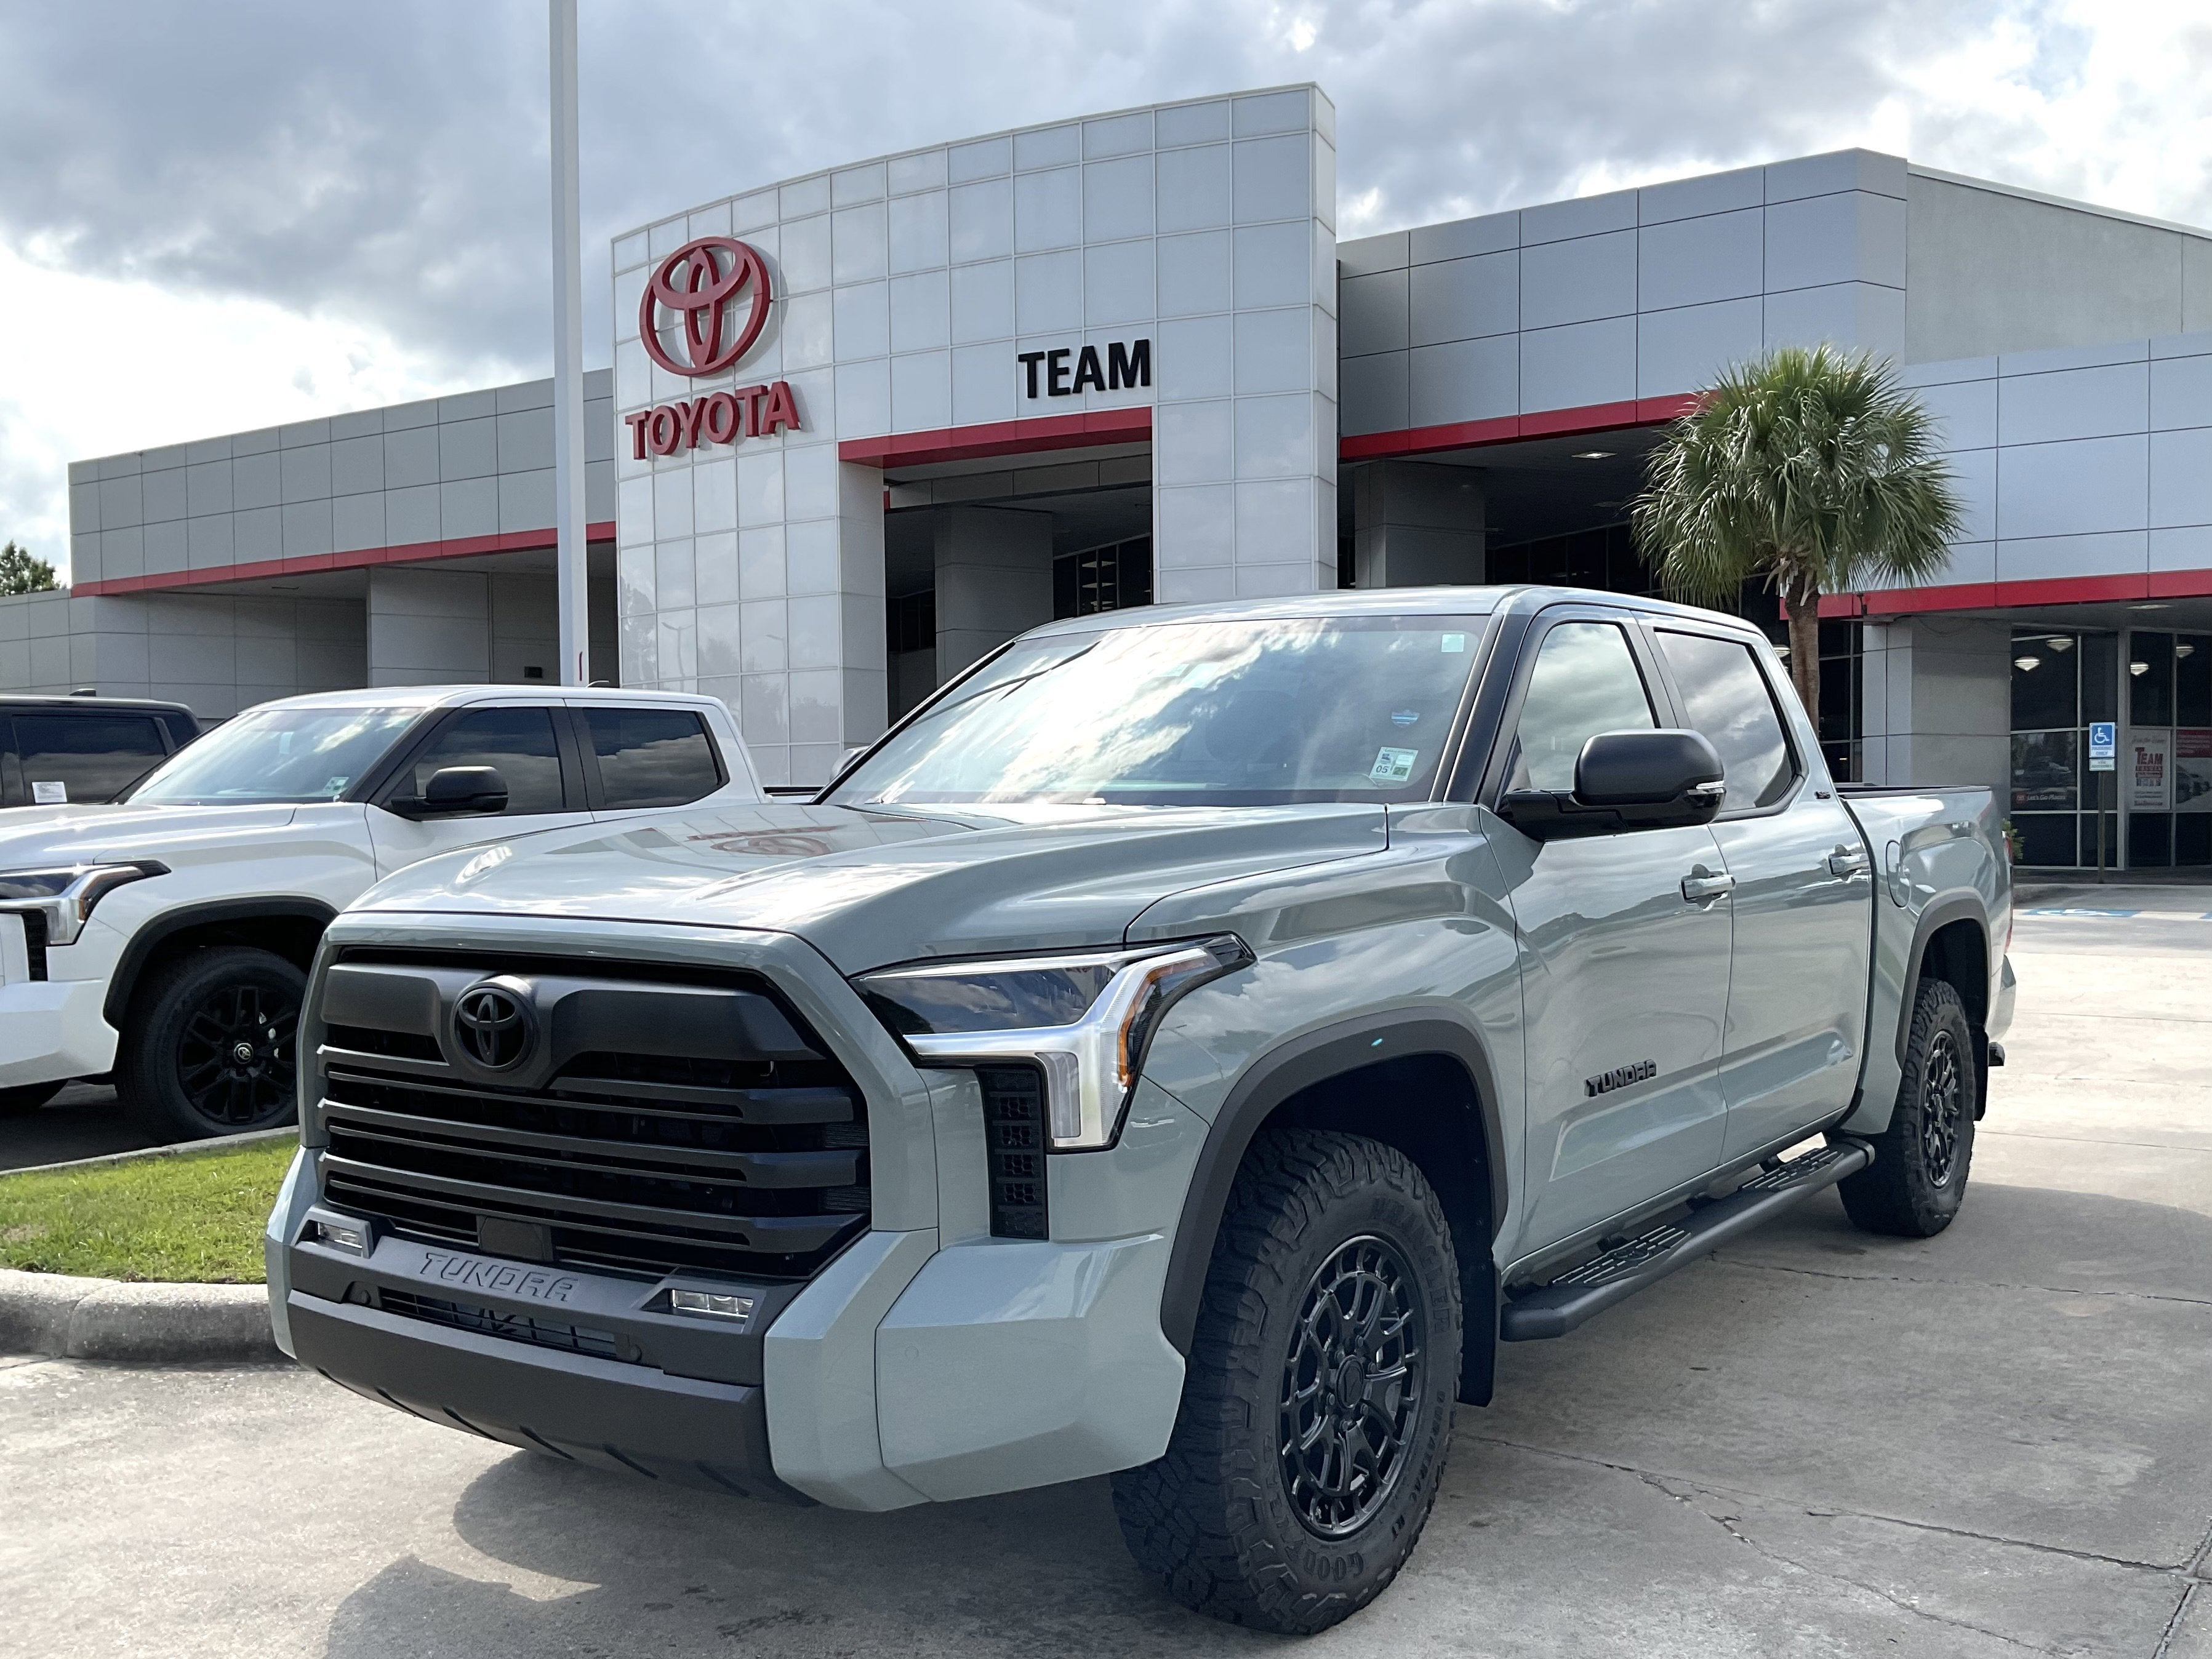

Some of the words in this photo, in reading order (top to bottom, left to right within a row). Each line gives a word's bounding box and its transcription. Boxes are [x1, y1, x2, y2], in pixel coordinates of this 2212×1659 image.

[1017, 338, 1151, 399] TEAM
[625, 381, 801, 460] TOYOTA
[1376, 765, 1389, 774] 05
[2135, 747, 2163, 765] TEAM
[1584, 1058, 1657, 1097] TUNDRA
[420, 1252, 579, 1302] TUNDRA
